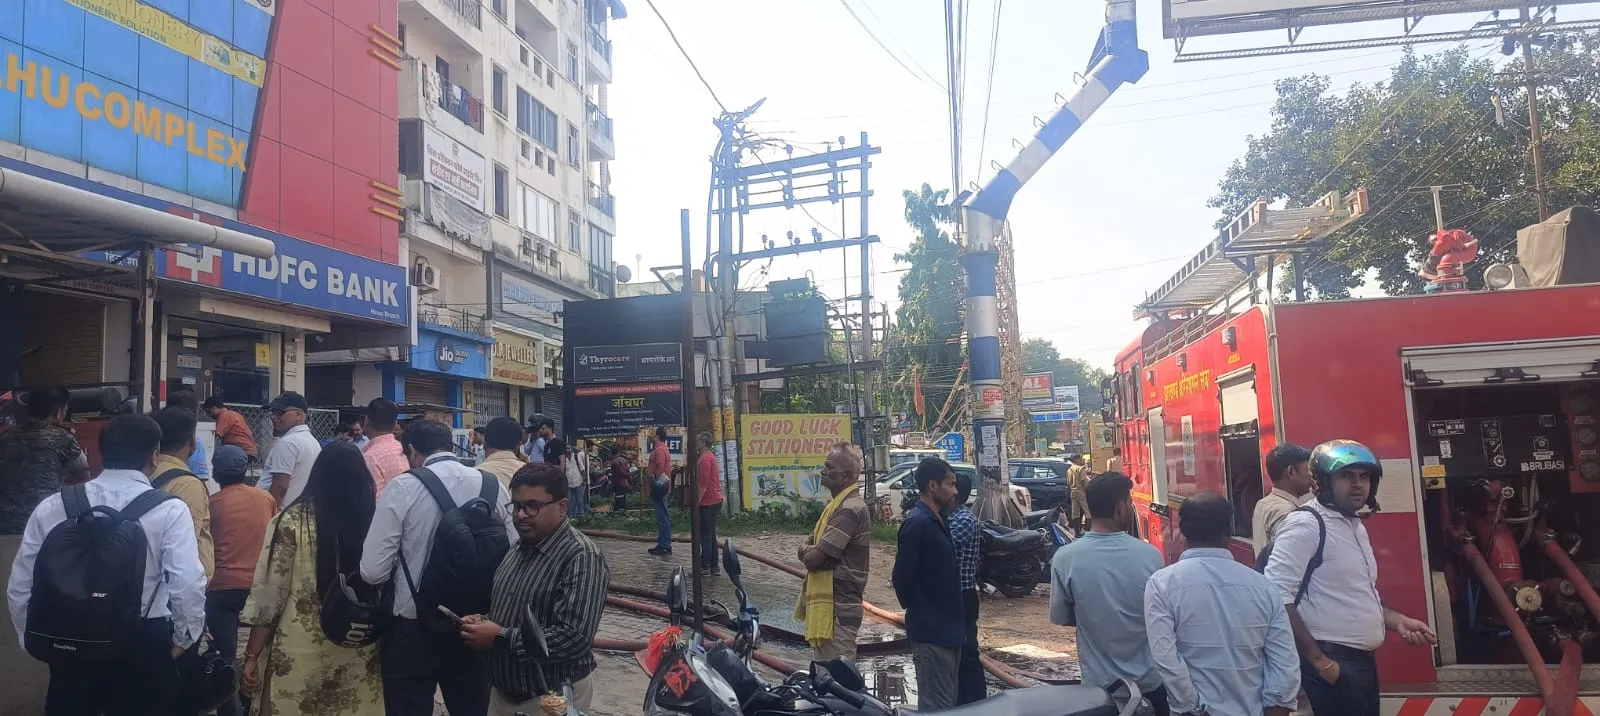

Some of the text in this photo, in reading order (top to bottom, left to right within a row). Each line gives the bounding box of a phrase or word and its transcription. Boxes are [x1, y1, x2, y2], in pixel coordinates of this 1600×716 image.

[119, 15, 167, 43] SOLUTION
[232, 252, 399, 308] HDFC BANK
[439, 346, 454, 362] Jio
[505, 343, 537, 366] JEWELLERS
[589, 355, 630, 364] Thyrocare
[750, 419, 794, 436] GOOD
[799, 418, 841, 435] LUCK
[1529, 460, 1565, 471] BRIJBASI
